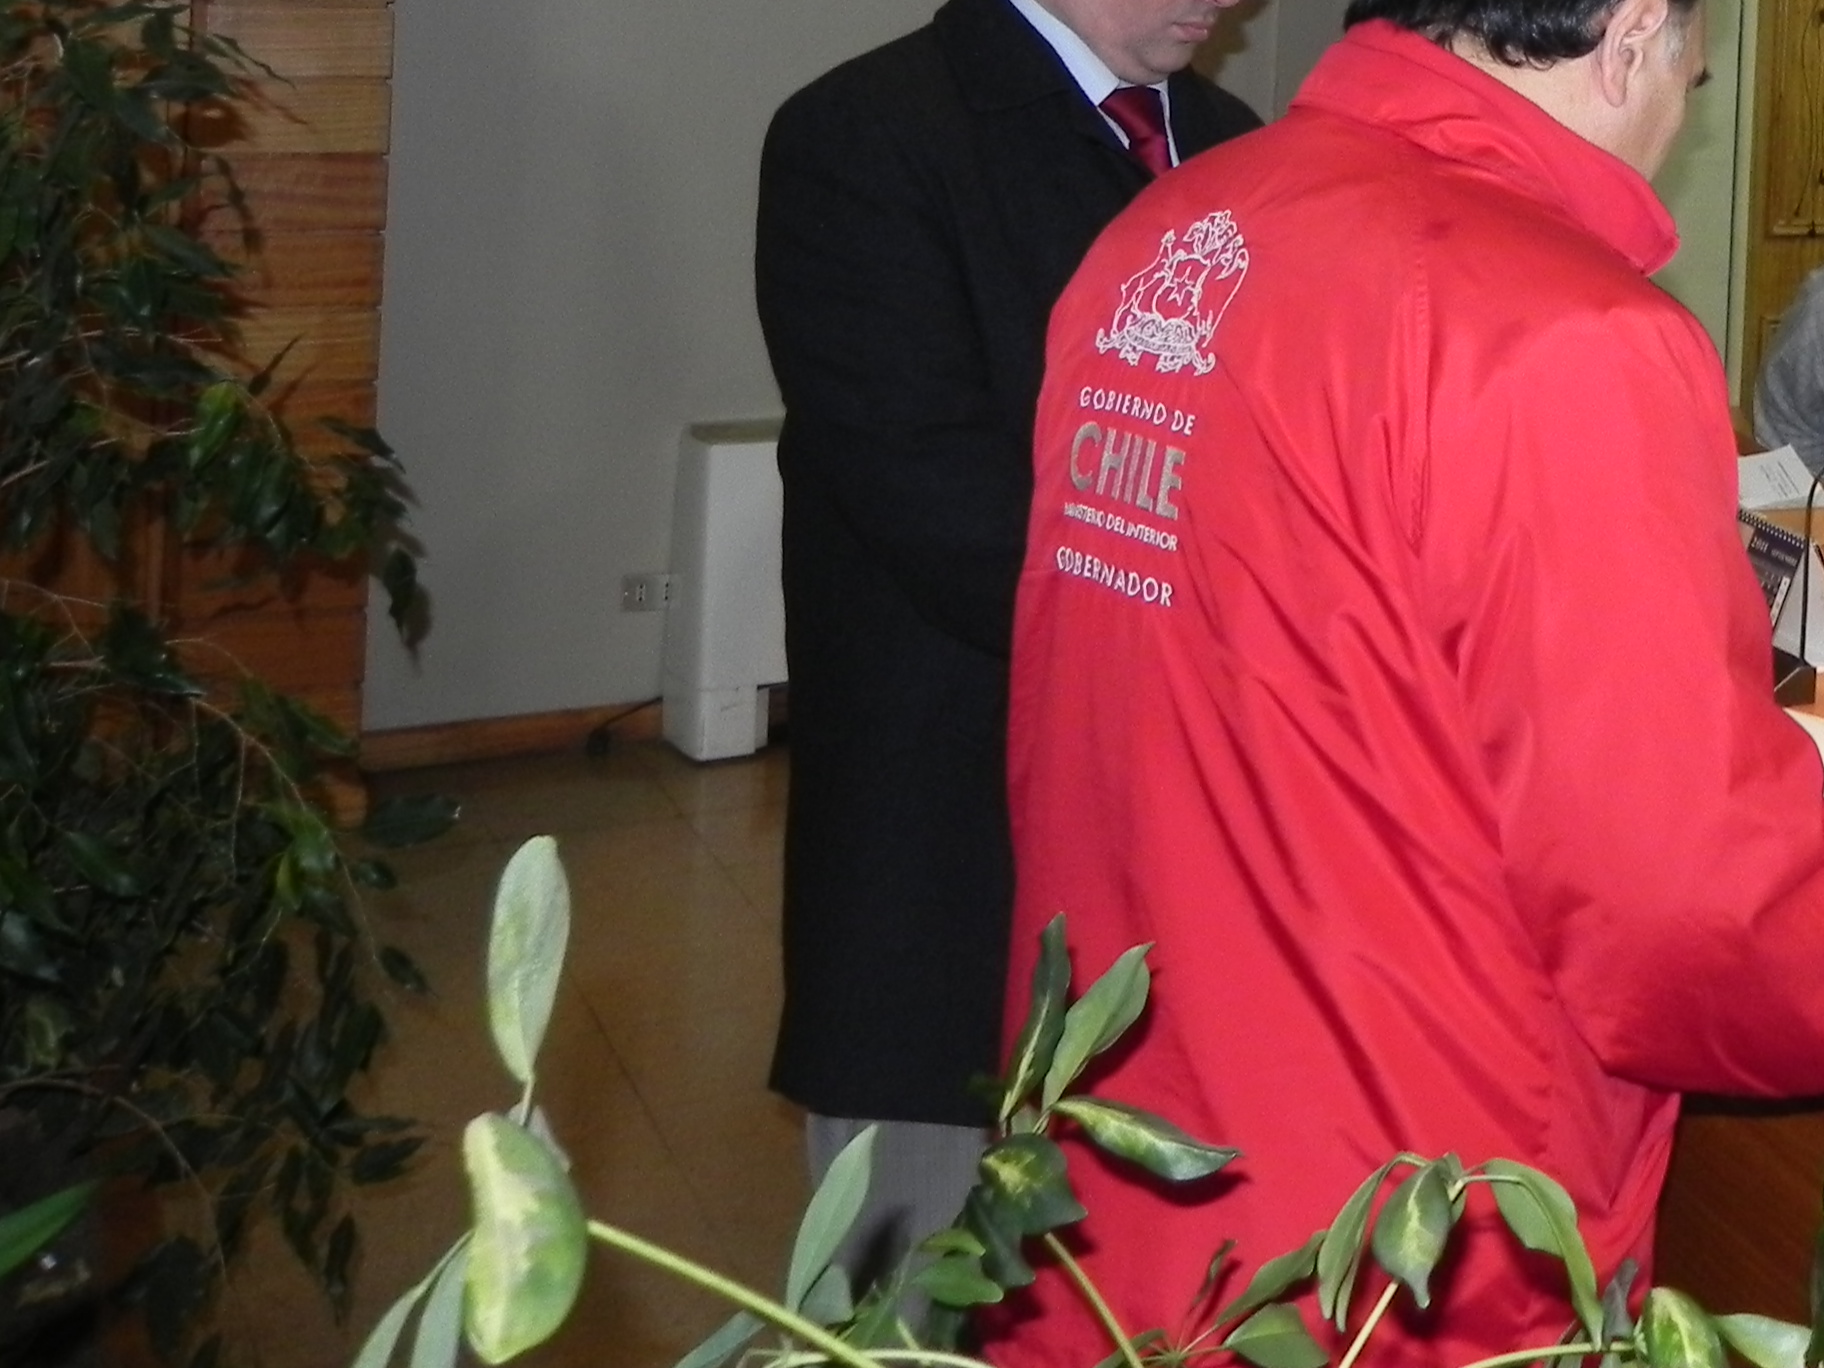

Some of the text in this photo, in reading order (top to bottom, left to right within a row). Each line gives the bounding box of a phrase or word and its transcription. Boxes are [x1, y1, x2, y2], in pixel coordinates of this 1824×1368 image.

[1079, 386, 1196, 436] GOBIERNO DE
[1070, 420, 1187, 521] CHILE
[1105, 513, 1126, 534] DEL
[1125, 522, 1179, 551] INTERIOR
[1056, 545, 1173, 608] GOBERNADOR
